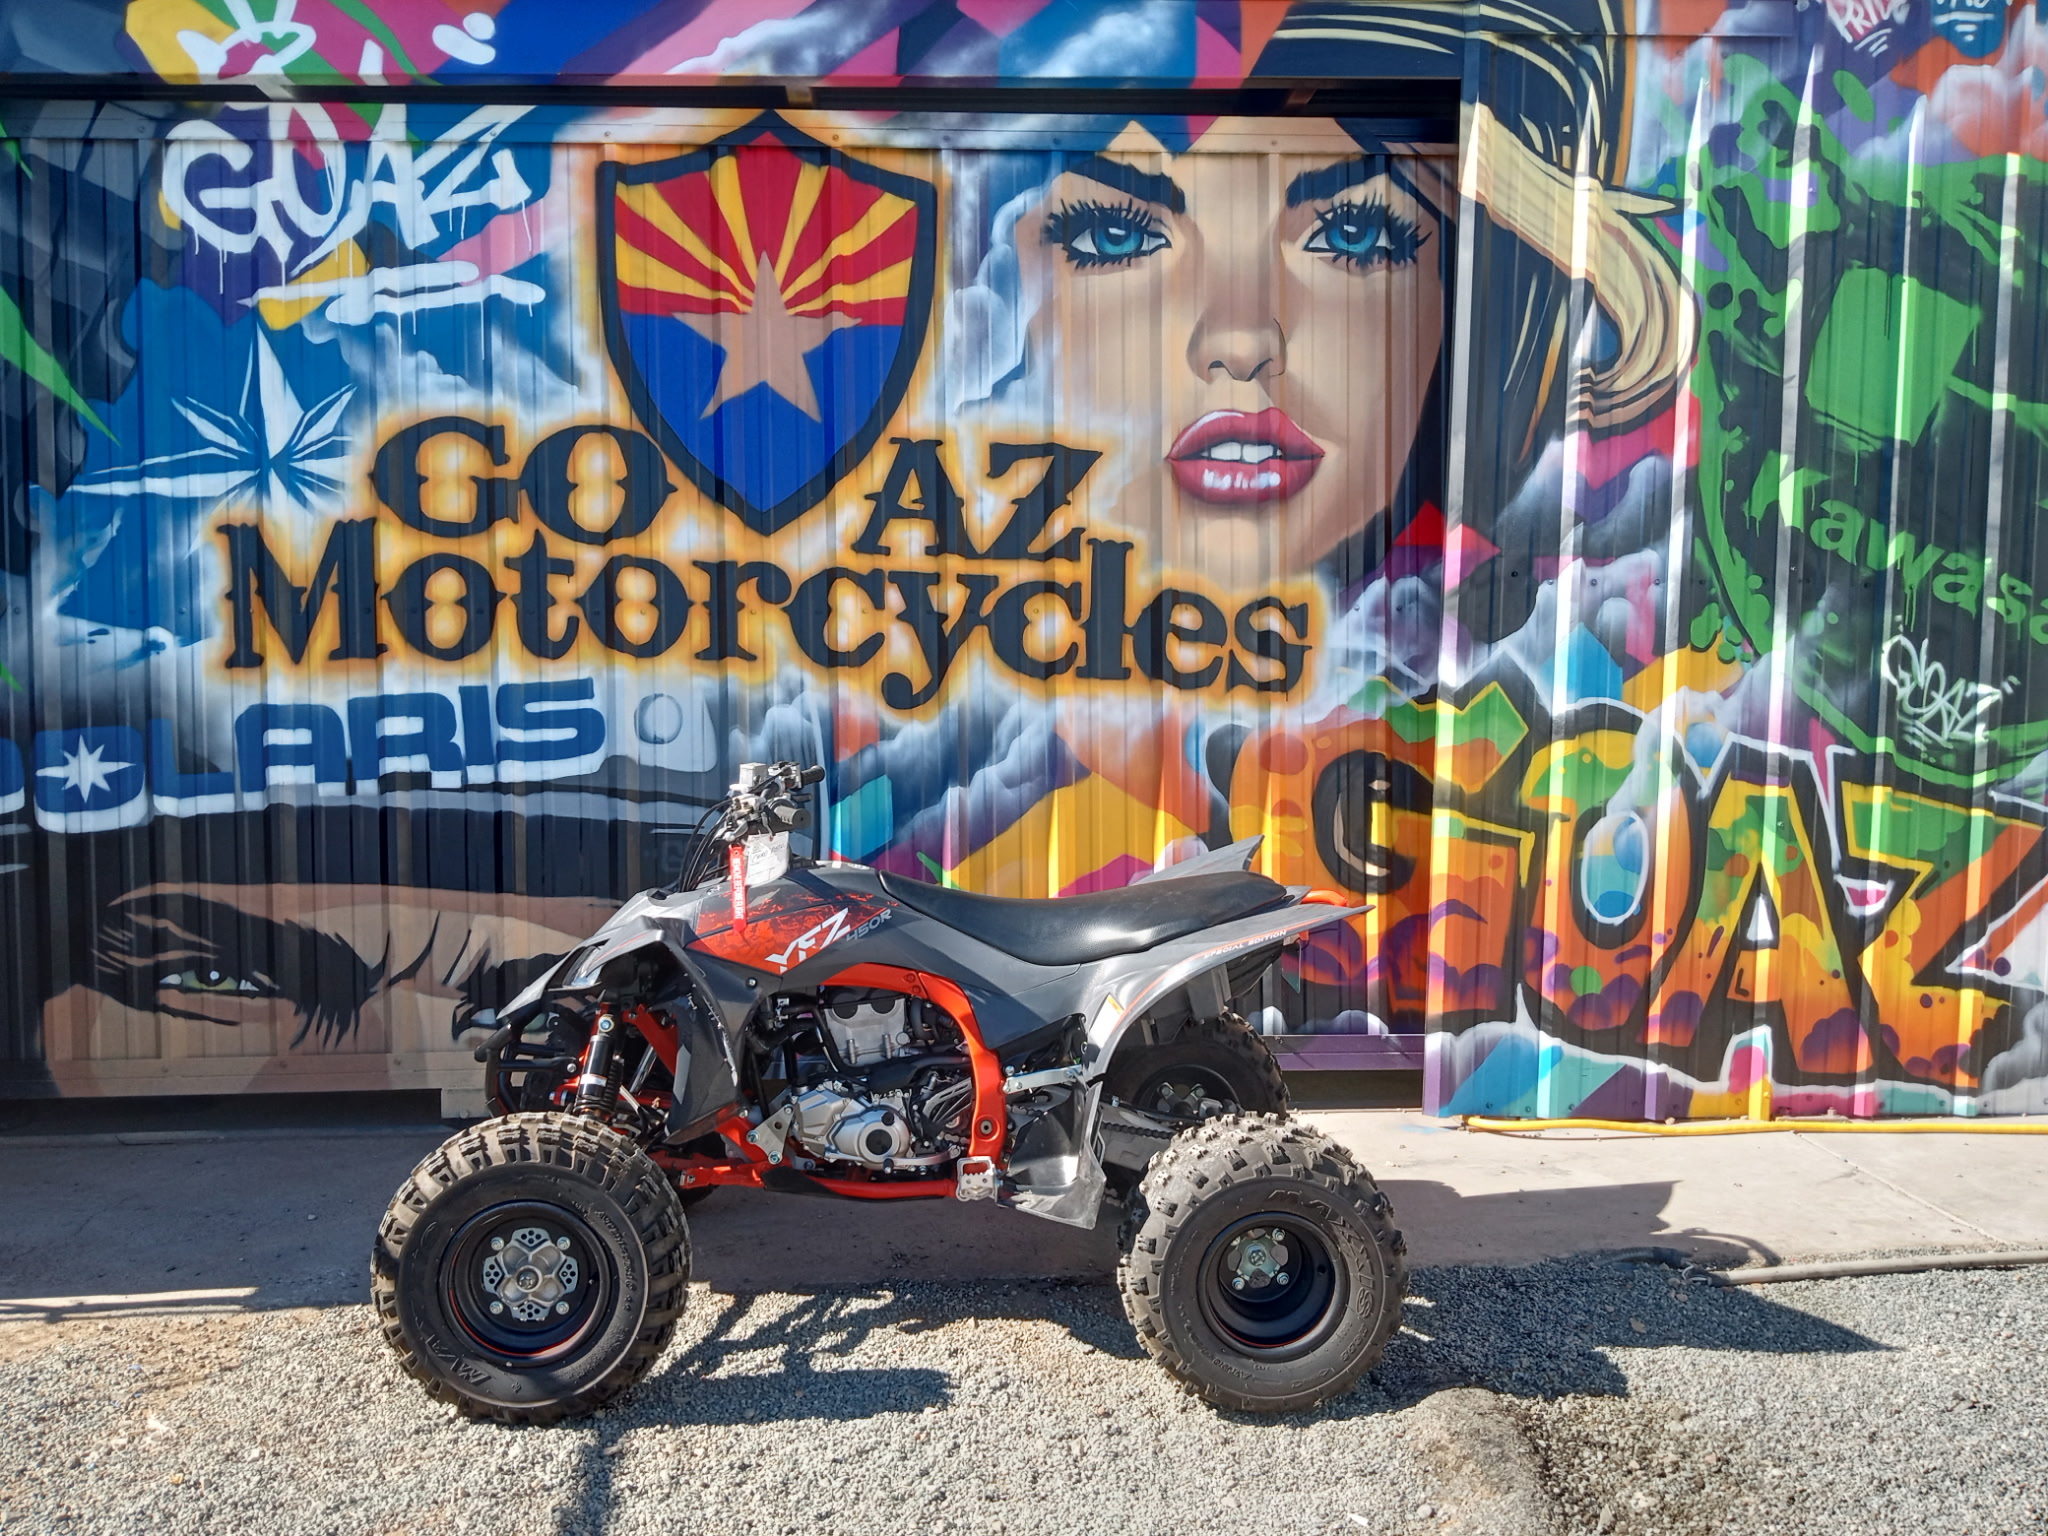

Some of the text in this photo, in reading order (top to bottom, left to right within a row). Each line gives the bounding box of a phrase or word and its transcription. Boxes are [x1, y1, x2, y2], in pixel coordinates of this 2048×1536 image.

[369, 416, 1103, 561] GO AZ
[217, 516, 1313, 709] Motorcycles
[0, 678, 606, 833] OLARIS
[764, 907, 893, 974] YFZ 450R
[1203, 929, 1288, 960] SPECIAL EDITION
